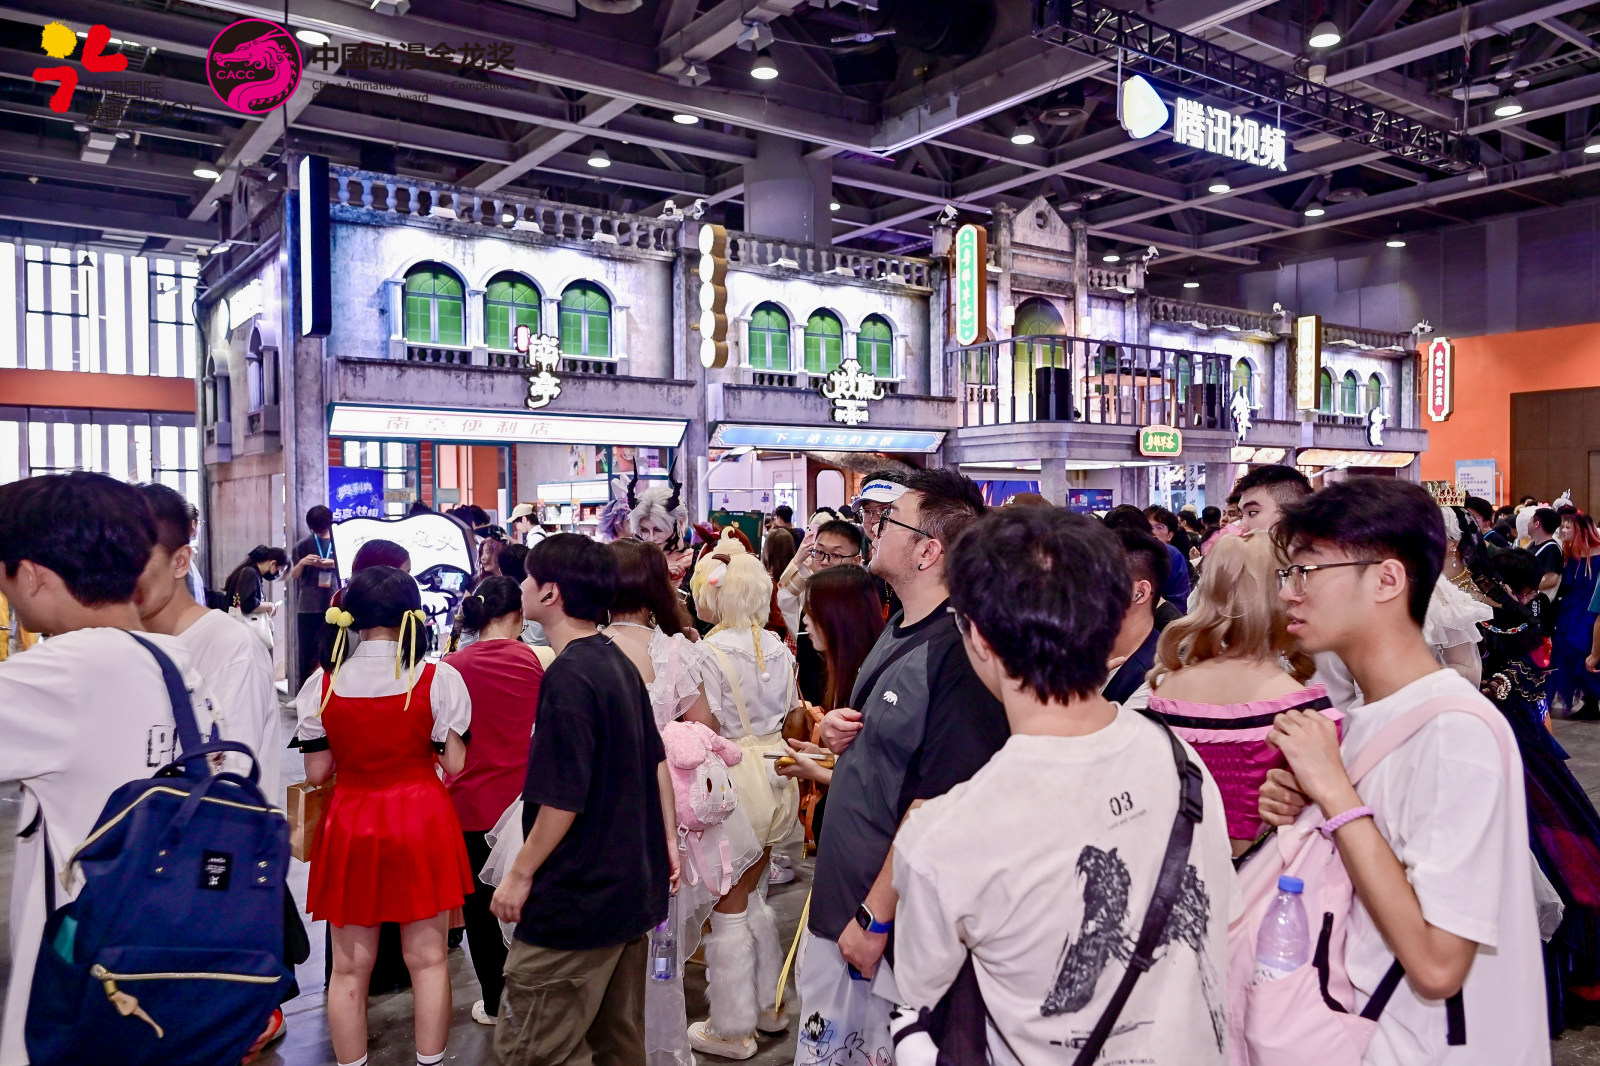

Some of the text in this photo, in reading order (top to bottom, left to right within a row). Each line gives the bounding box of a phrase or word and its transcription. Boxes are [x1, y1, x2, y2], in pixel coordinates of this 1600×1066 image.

[1174, 97, 1287, 171] 腾讯视频
[1109, 791, 1133, 817] 03
